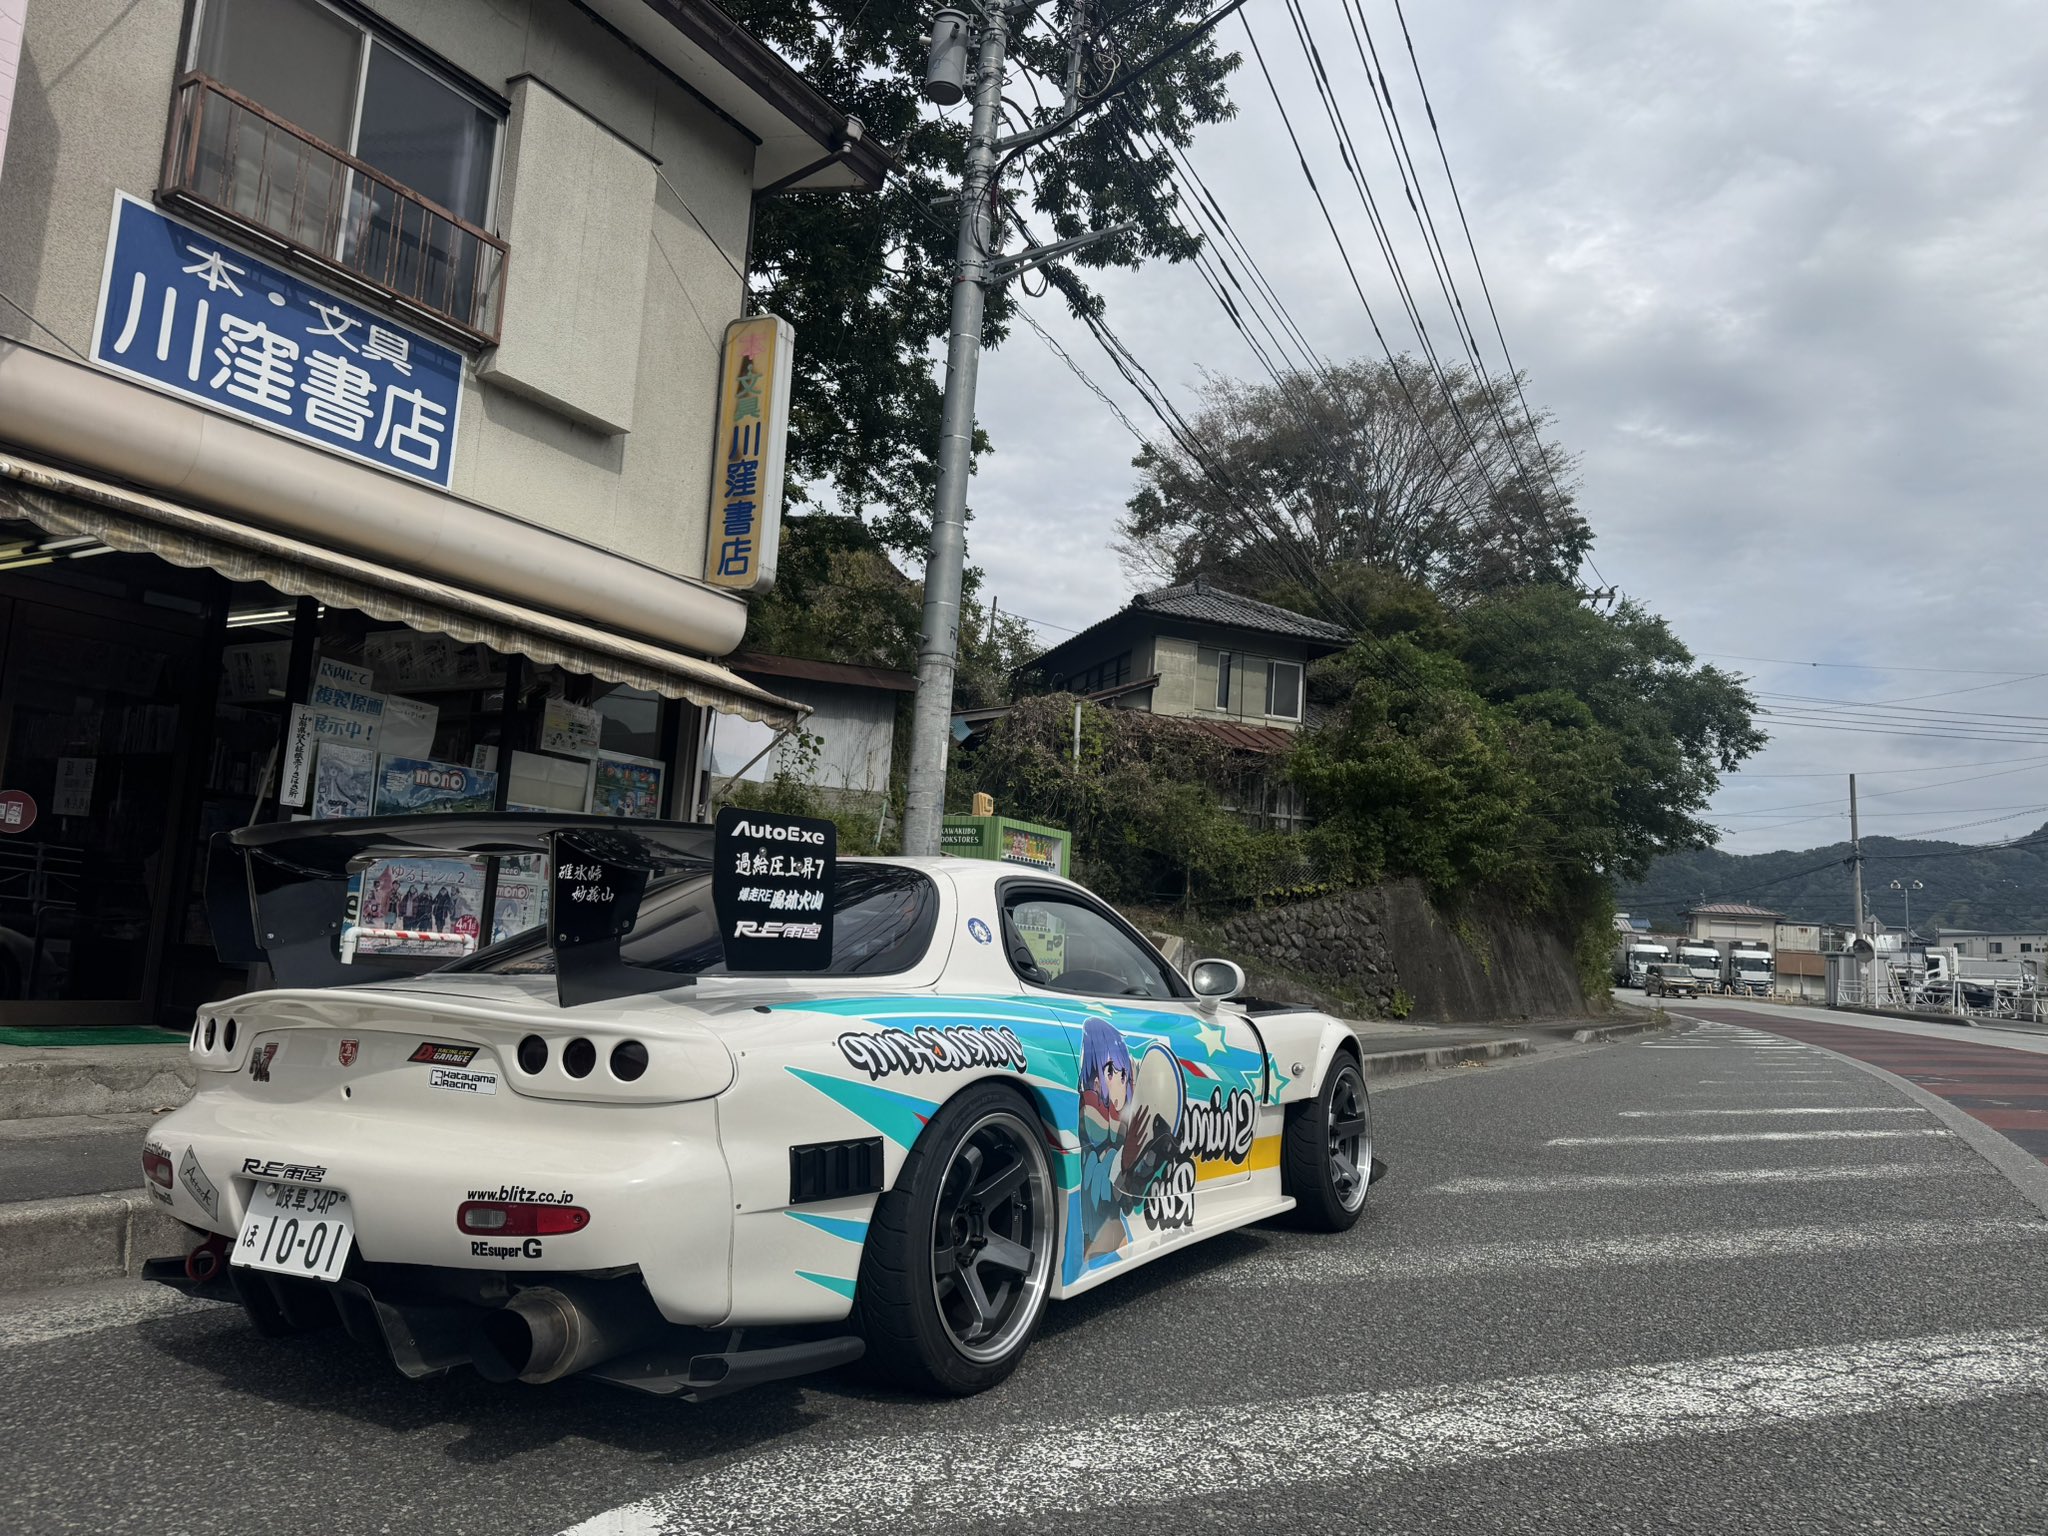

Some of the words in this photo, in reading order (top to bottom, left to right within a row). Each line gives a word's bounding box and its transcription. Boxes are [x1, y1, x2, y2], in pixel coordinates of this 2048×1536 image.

[182, 244, 413, 377] 本・文具
[114, 271, 447, 470] 川窪書店
[717, 421, 761, 576] 川窪書店
[320, 662, 369, 685] 店内にて
[315, 684, 384, 716] 複製原画
[314, 714, 373, 740] 展示中！
[414, 768, 466, 792] mono
[731, 820, 825, 845] AutoExe
[496, 884, 529, 900] mono
[433, 1052, 470, 1063] GARAGE
[442, 1079, 477, 1092] Racing
[443, 1070, 496, 1084] Katayama
[276, 1186, 307, 1210] 岐阜
[307, 1189, 338, 1214] 34P
[467, 1186, 573, 1204] www.blitz.co.jp
[260, 1215, 344, 1272] 10-01
